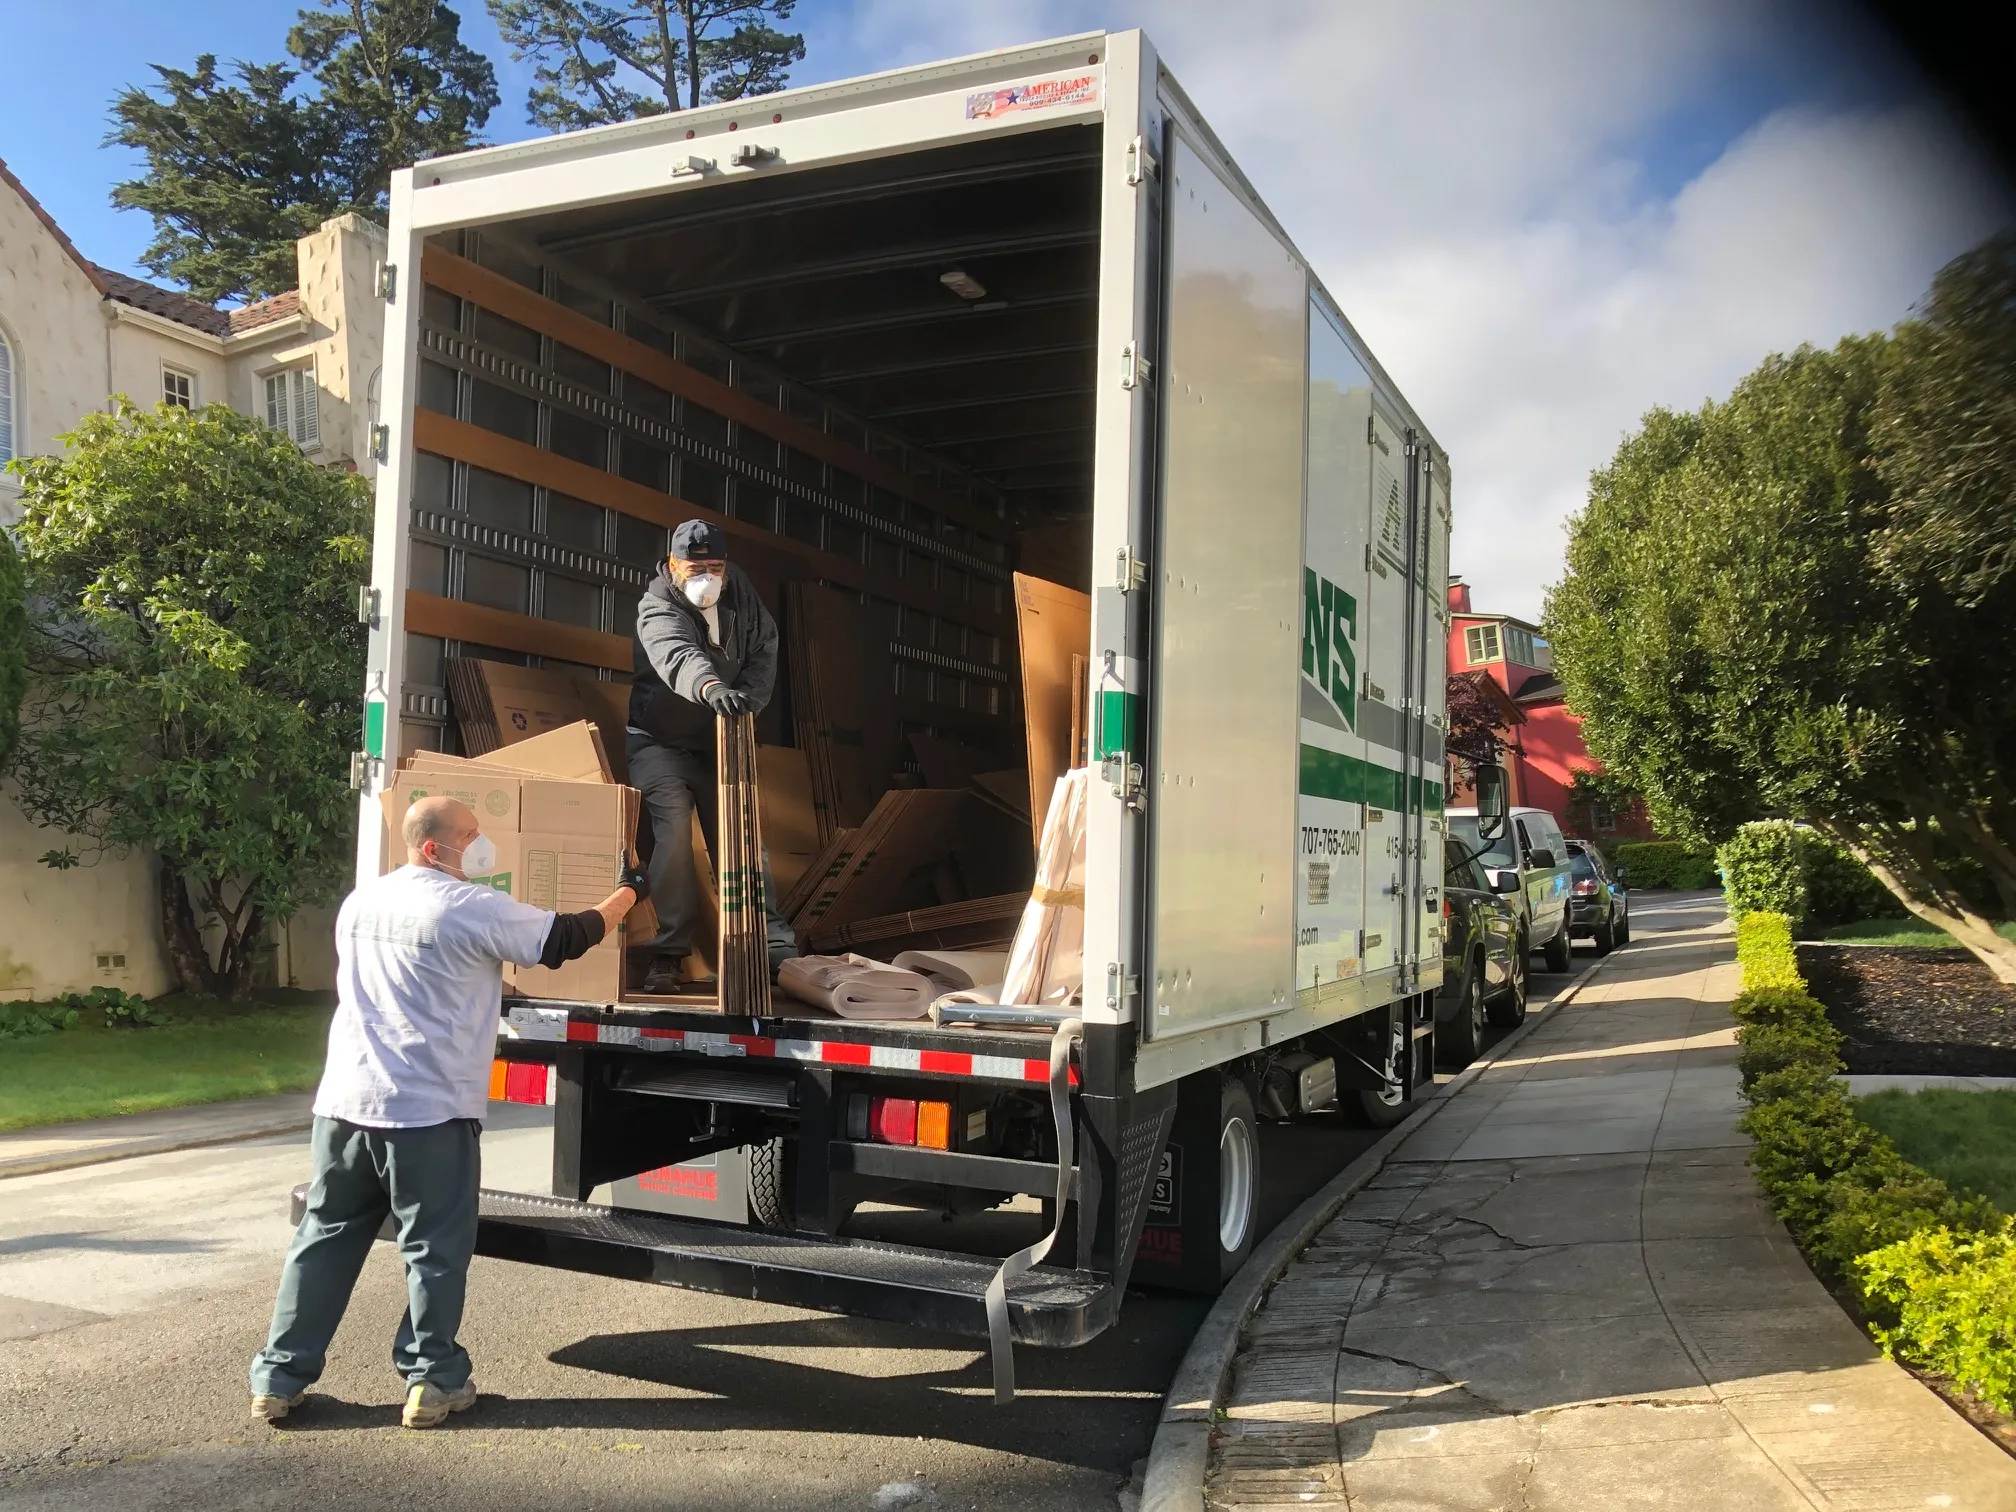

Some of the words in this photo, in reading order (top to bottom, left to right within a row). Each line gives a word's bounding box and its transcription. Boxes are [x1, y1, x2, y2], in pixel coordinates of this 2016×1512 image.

[1022, 76, 1091, 98] AMERICAN
[1302, 826, 1360, 856] 707-765-2040
[1298, 926, 1319, 947] .com
[638, 1181, 670, 1194] TRUCK
[672, 1185, 717, 1201] CENTERS
[1148, 1204, 1171, 1214] mpany
